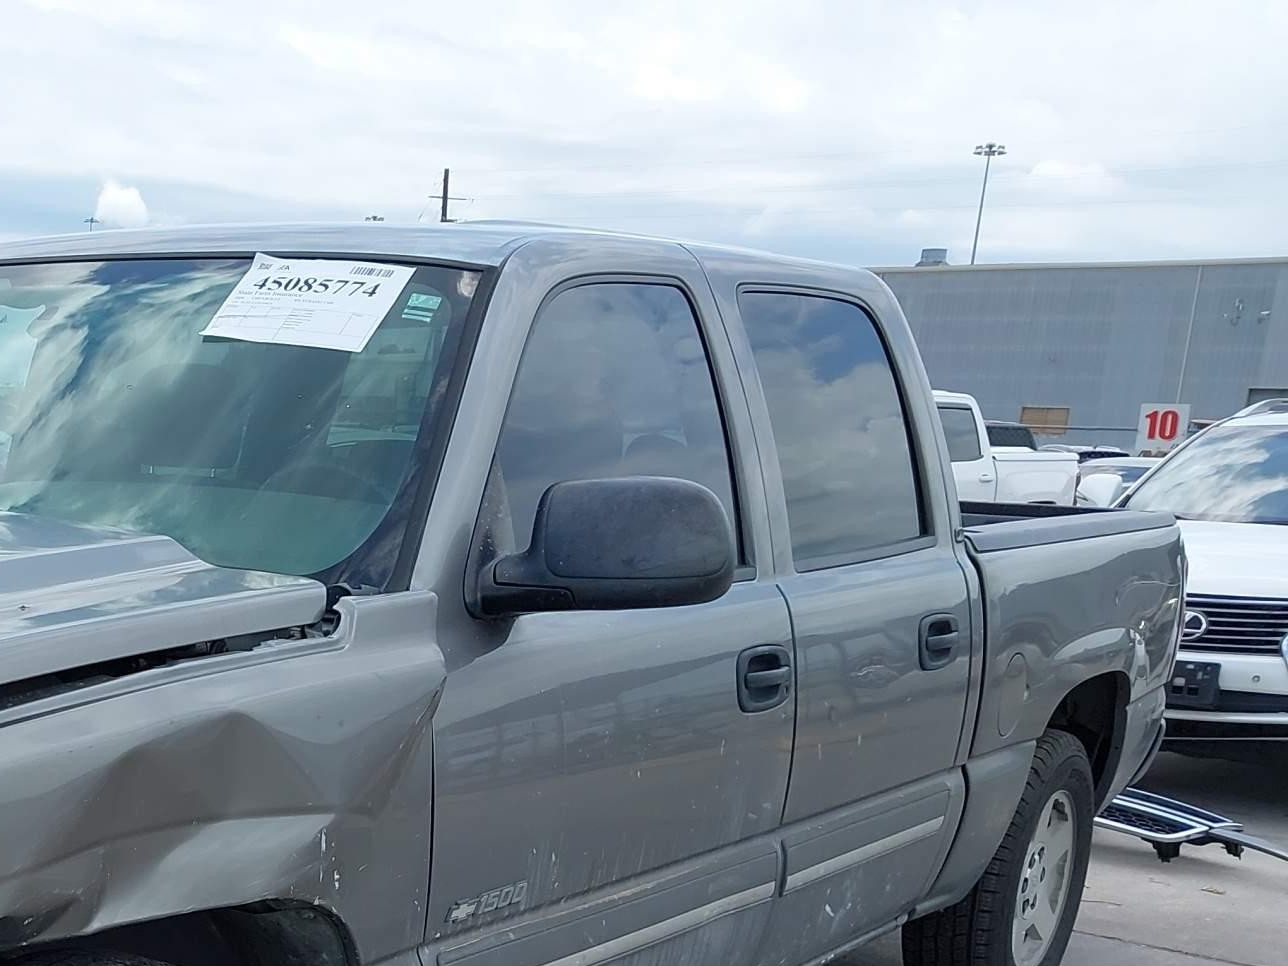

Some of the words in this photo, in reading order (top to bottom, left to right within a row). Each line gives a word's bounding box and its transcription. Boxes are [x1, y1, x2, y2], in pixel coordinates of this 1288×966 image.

[253, 275, 381, 298] 45085774
[1145, 410, 1179, 441] 10
[479, 881, 528, 914] 1500
